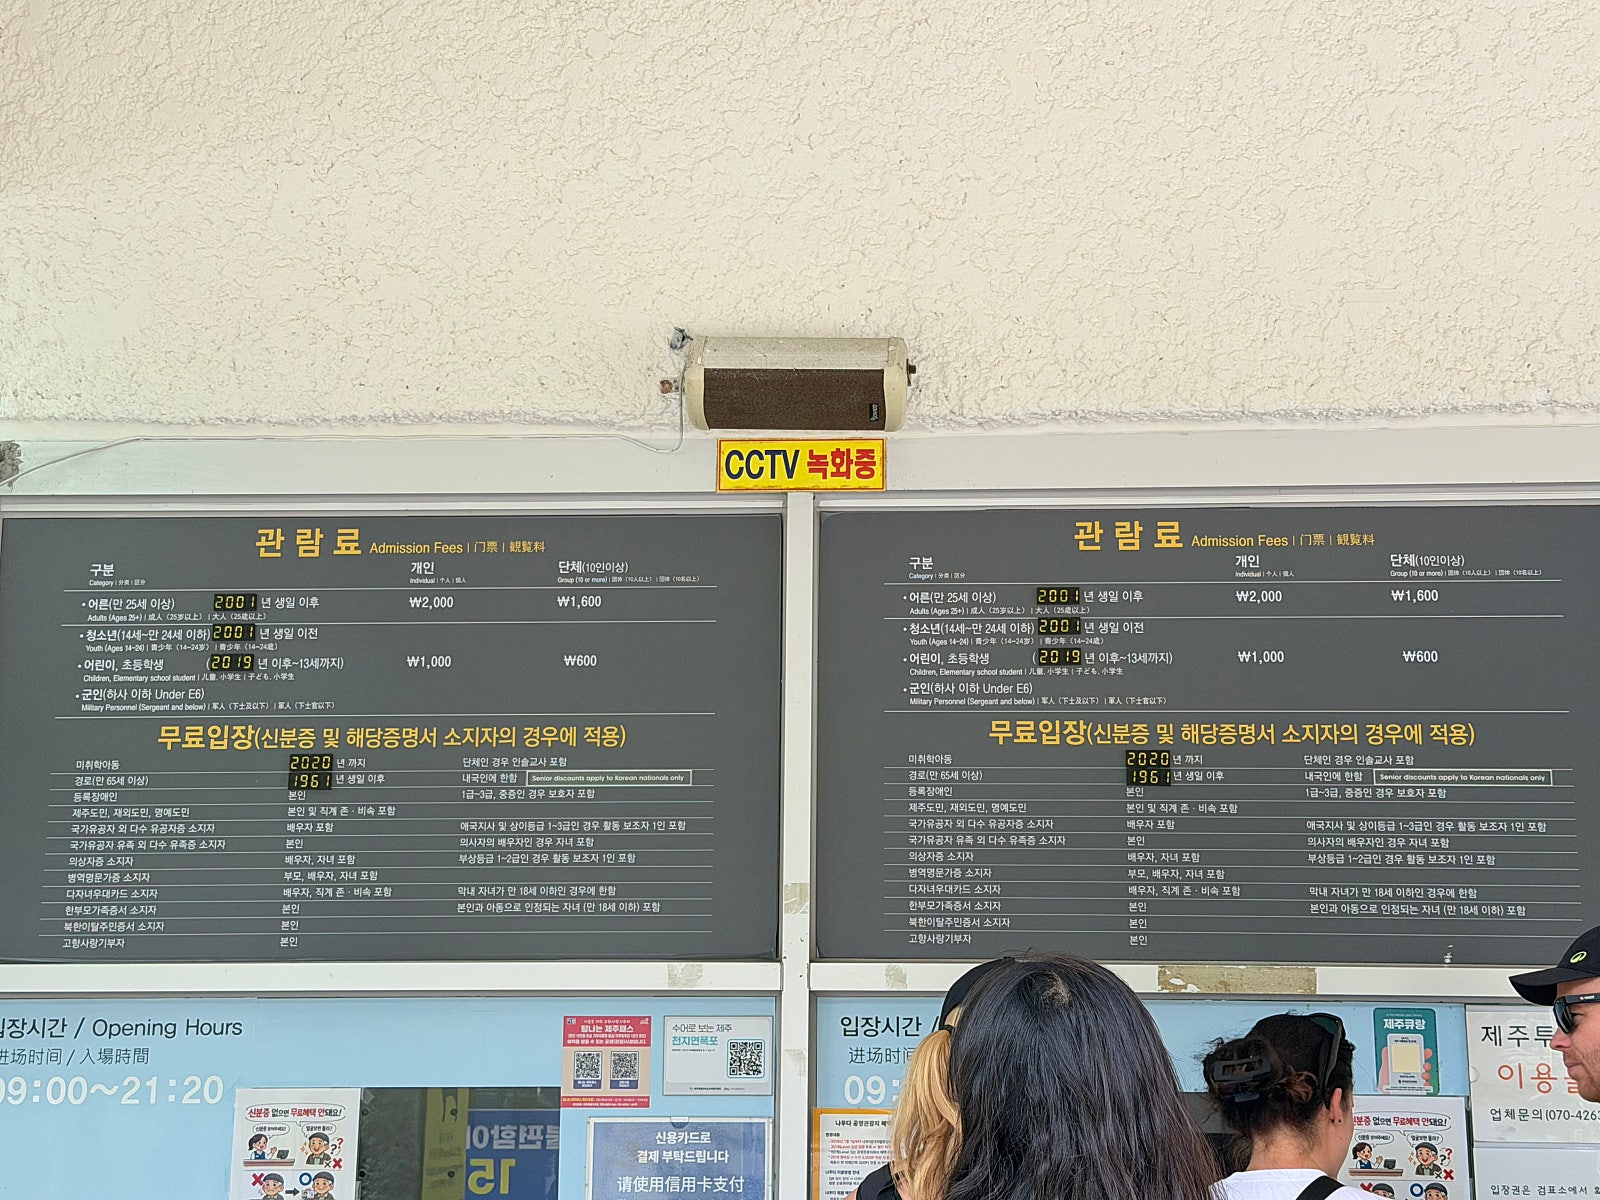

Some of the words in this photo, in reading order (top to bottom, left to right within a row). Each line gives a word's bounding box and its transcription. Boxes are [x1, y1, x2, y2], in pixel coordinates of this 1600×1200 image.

[725, 449, 799, 479] CCTV
[807, 448, 876, 479] 녹화중
[1191, 534, 1254, 547] Admission
[1258, 535, 1288, 547] Fees
[1300, 534, 1325, 546] 门票
[1337, 533, 1375, 546] 観覧料
[370, 541, 430, 554] Admission
[434, 542, 463, 554] Fees
[474, 541, 498, 552] 门票
[509, 541, 545, 552] 観覧料
[90, 564, 114, 577] 구분
[411, 561, 434, 574] 개인
[558, 561, 628, 574] 단체(10인이상)
[1390, 570, 1408, 578] Group
[89, 579, 114, 587] Category
[88, 598, 125, 610] 어른(만
[127, 599, 147, 610] 25세
[151, 598, 174, 610] 이상)
[215, 595, 256, 609] 2001
[261, 597, 271, 609] 년
[275, 597, 295, 609] 생일
[299, 597, 319, 609] 이후
[409, 596, 453, 610] ₩2,000
[557, 596, 601, 609] ₩1,600
[88, 613, 107, 621] Adults
[109, 613, 127, 622] (Ages
[128, 613, 142, 622] 25+)
[985, 623, 1006, 635] 24세
[1010, 623, 1035, 636] 이하)
[1039, 619, 1080, 633] 2001
[1084, 622, 1094, 634] 년
[1098, 621, 1119, 634] 생일
[1123, 621, 1144, 634] 이전
[929, 638, 948, 647] (Ages
[84, 658, 118, 672] 어린이,
[122, 658, 164, 671] 초등학생
[258, 658, 268, 670] 년
[407, 655, 451, 669] ₩1,000
[564, 654, 597, 667] ₩600
[909, 668, 938, 677] Children,
[940, 668, 975, 677] Elementary
[976, 668, 997, 676] school
[999, 668, 1022, 676] student
[82, 688, 127, 702] 군인(하사
[131, 688, 152, 701] 이하
[155, 689, 185, 700] Under
[188, 688, 204, 701] E6)
[910, 698, 931, 706] Military
[967, 698, 999, 706] (Sergeant
[1014, 698, 1035, 706] below)
[158, 724, 315, 750] 무료입장(신분증
[323, 728, 339, 748] 및
[347, 728, 437, 748] 해당증명서
[443, 727, 516, 747] 소지자의
[522, 726, 577, 747] 경우에
[583, 725, 627, 747] 적용)
[989, 720, 1149, 745] 무료입장(신분증
[1158, 723, 1174, 744] 및
[1181, 723, 1275, 745] 해당증명서
[1282, 724, 1358, 744] 소지자의
[1365, 723, 1422, 744] 경우에
[1429, 723, 1475, 745] 적용)
[76, 760, 120, 771] 미취학아동
[291, 756, 331, 769] 2020
[336, 759, 345, 768] 년
[348, 758, 365, 768] 까지
[1304, 755, 1331, 765] 단체인
[1334, 755, 1352, 765] 경우
[1356, 755, 1392, 766] 인솔교사
[1396, 755, 1414, 765] 포함
[553, 774, 584, 782] discounts
[586, 775, 605, 783] apply
[670, 774, 684, 782] only
[908, 770, 938, 782] 경로(만
[941, 770, 958, 781] 65세
[962, 770, 983, 782] 이상)
[1132, 769, 1170, 784] 1961
[1173, 771, 1182, 781] 년
[1185, 770, 1202, 781] 생일
[1207, 770, 1224, 781] 이후
[1305, 771, 1341, 782] 내국인에
[1345, 771, 1363, 782] 한함
[908, 786, 952, 797] 등록장애인
[1126, 787, 1144, 797] 본인
[71, 823, 114, 834] 국가유공자
[118, 823, 127, 834] 외
[130, 823, 147, 834] 다수
[151, 823, 185, 834] 유공자증
[188, 823, 215, 834] 소지자
[287, 822, 312, 833] 배우자
[316, 822, 334, 833] 포함
[909, 934, 971, 944] 고향사랑기부자
[1129, 935, 1148, 946] 본인
[0, 1016, 68, 1039] 장시간
[92, 1018, 176, 1039] Opening
[186, 1018, 243, 1037] Hours
[672, 1024, 696, 1032] 수어로
[698, 1024, 714, 1032] 보는
[716, 1024, 732, 1032] 제주
[840, 1016, 922, 1038] 입장시간
[672, 1036, 718, 1046] 천지연폭포
[79, 1047, 149, 1066] 入場時間
[0, 1074, 224, 1105] 9:00~21:20
[248, 1108, 270, 1118] 신분증
[272, 1108, 289, 1117] 없으면
[290, 1108, 316, 1117] 무료혜택
[1373, 1116, 1391, 1126] 없으면
[1393, 1117, 1420, 1126] 무료혜택
[655, 1132, 711, 1144] 신용카드로
[637, 1151, 659, 1163] 결제
[662, 1150, 729, 1163] 부탁드립니다
[617, 1176, 744, 1193] 请使用信用卡支付
[1491, 1185, 1530, 1195] 입장권은
[1537, 1185, 1588, 1195] 검표소에서
